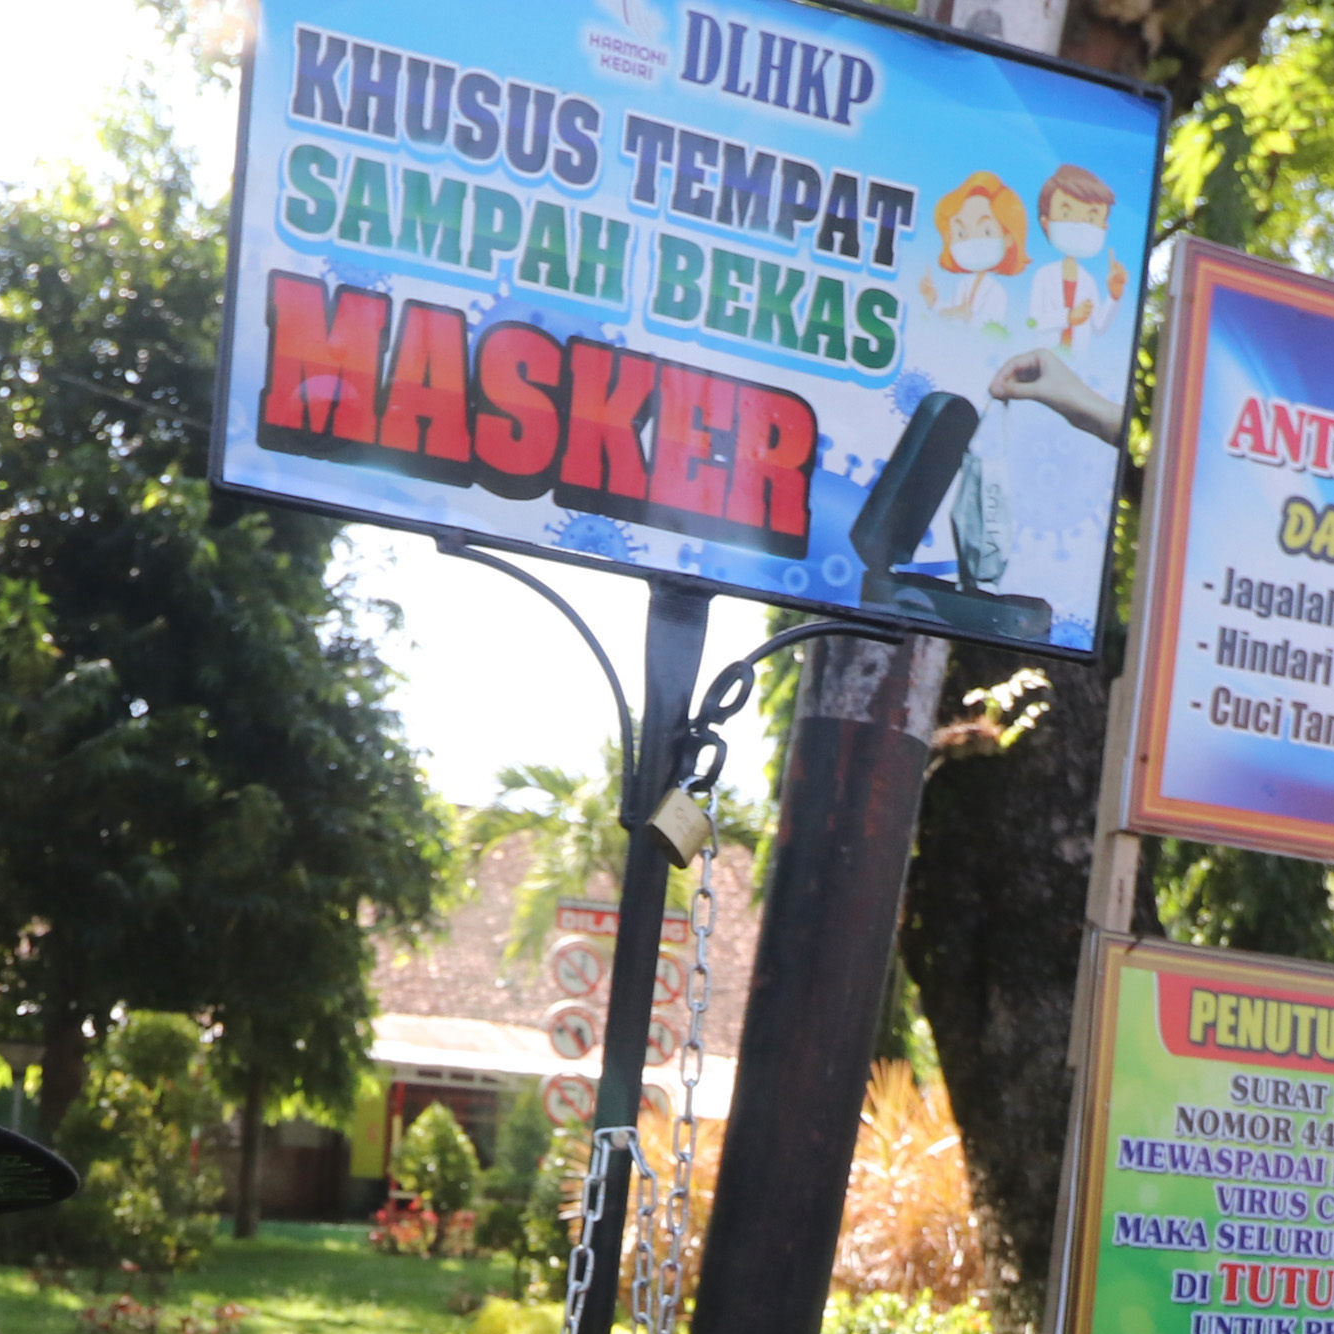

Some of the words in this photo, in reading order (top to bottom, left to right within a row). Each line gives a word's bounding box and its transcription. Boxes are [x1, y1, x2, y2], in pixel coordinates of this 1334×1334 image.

[589, 32, 666, 66] HARMONI
[600, 53, 653, 80] KEDIRI
[681, 10, 874, 126] DLHKP
[292, 27, 599, 186] KHUSUS
[624, 116, 916, 269] TEMPAT
[284, 143, 629, 305] SAMPAH
[653, 232, 899, 372] BEKAS
[266, 272, 817, 542] MASKER
[1217, 627, 1333, 685] Hindari
[1210, 687, 1280, 736] Cuci
[1231, 1076, 1327, 1111] SURAT
[1176, 1107, 1291, 1142] NOMOR
[1119, 1138, 1324, 1186] MEWASPADAI
[1216, 1185, 1308, 1220] VIRUS
[1114, 1214, 1207, 1249] MAKA
[1173, 1272, 1211, 1302] DI
